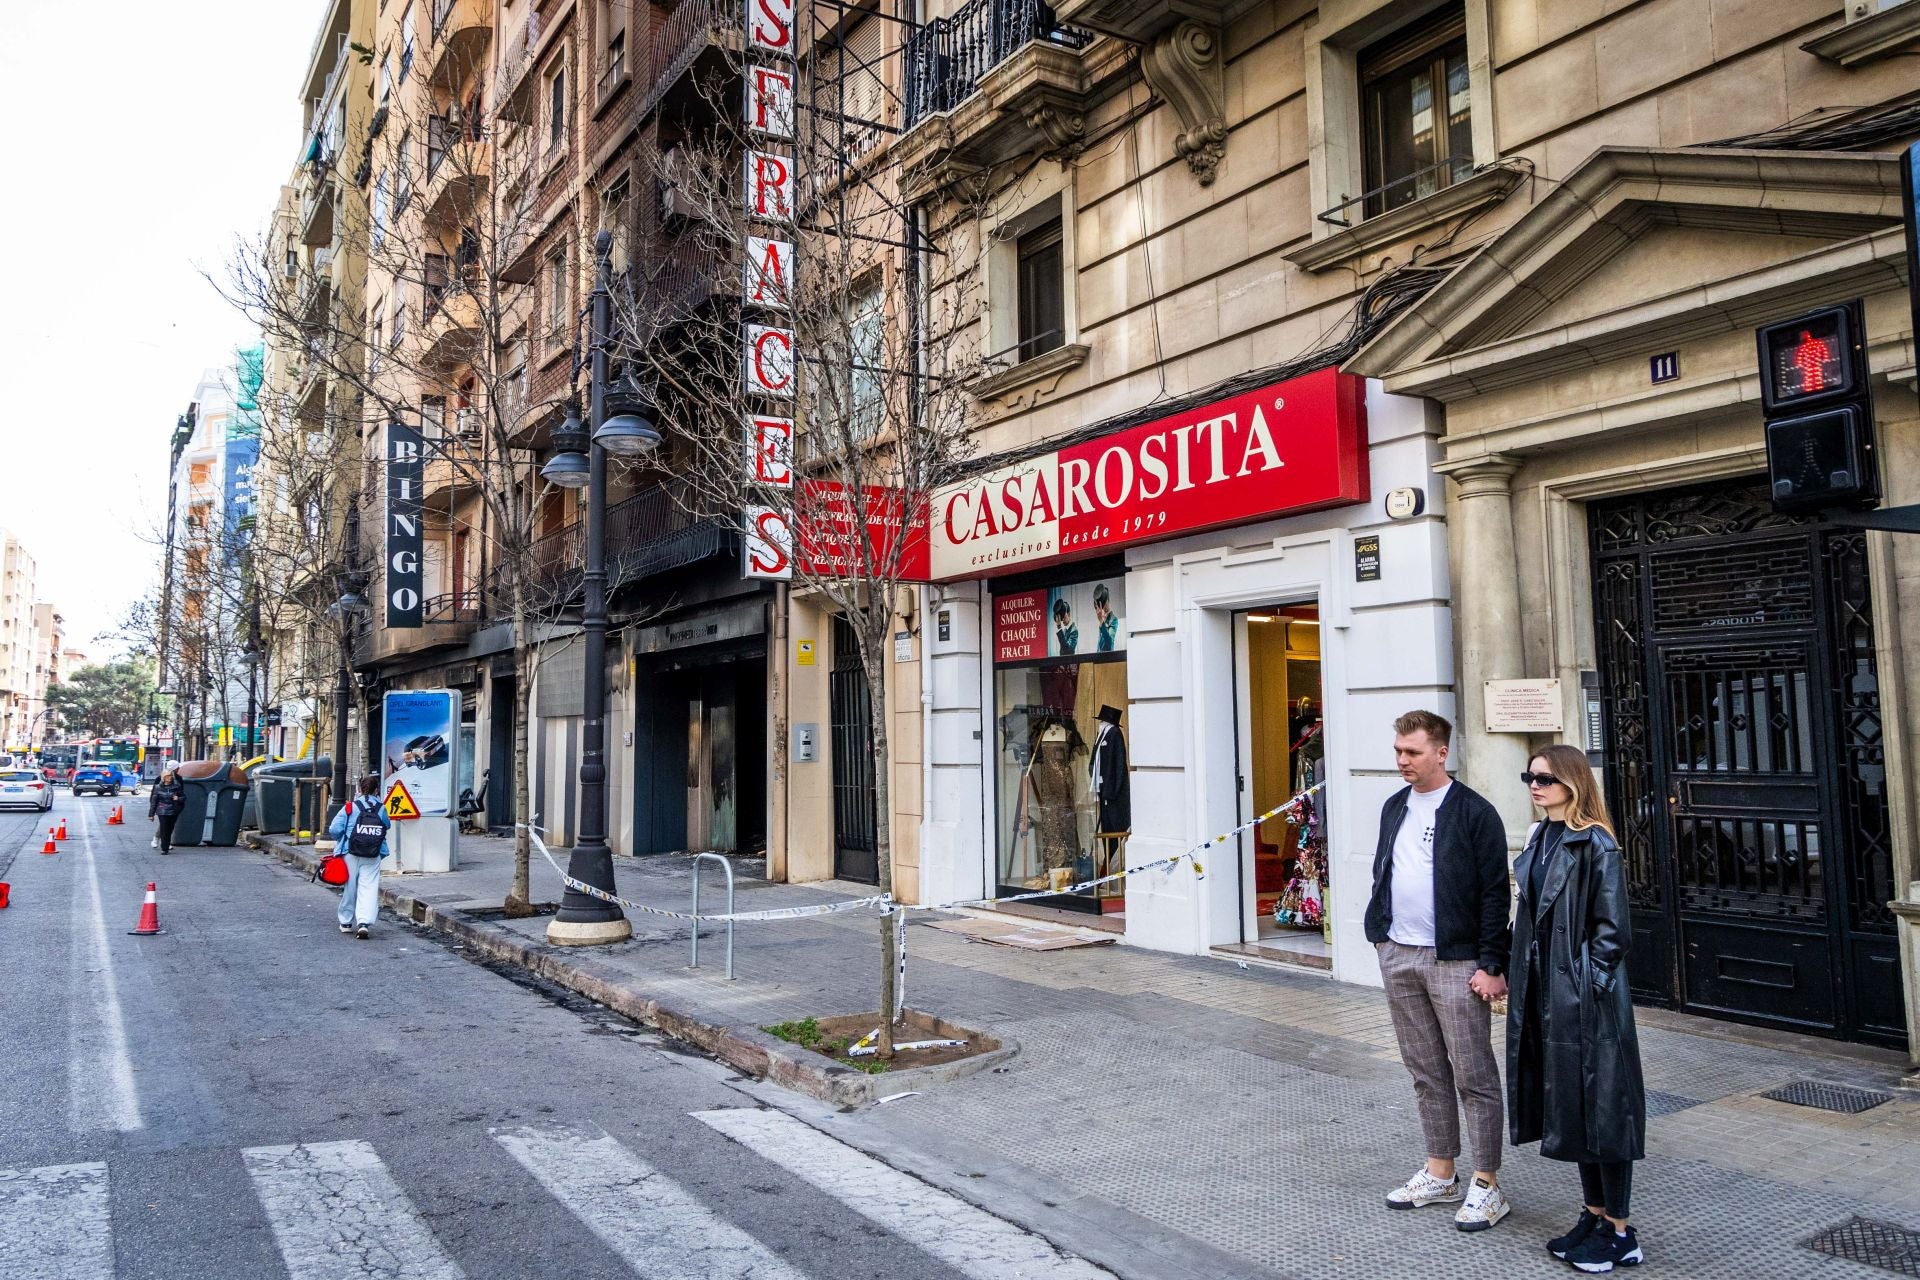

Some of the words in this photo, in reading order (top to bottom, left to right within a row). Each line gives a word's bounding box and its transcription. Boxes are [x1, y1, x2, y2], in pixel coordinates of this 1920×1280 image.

[1657, 357, 1672, 378] 11
[945, 468, 1059, 545] CASA
[1058, 403, 1285, 520] ROSITA
[815, 490, 861, 502] ALQUI
[392, 441, 418, 611] BINGO
[813, 511, 867, 523] DISFRA
[869, 516, 882, 525] DE
[883, 517, 925, 528] CALAD
[814, 533, 861, 545] ETIQEA
[971, 538, 1051, 566] exclusivos
[1062, 525, 1109, 546] desde
[1123, 511, 1168, 534] 1979
[813, 555, 863, 567] REGIOL
[1001, 597, 1035, 611] ALQUILER:
[1001, 609, 1041, 625] SMOKING
[1001, 624, 1036, 643] CHAQUÉ
[1001, 645, 1031, 658] FRACH
[356, 824, 383, 836] VANS
